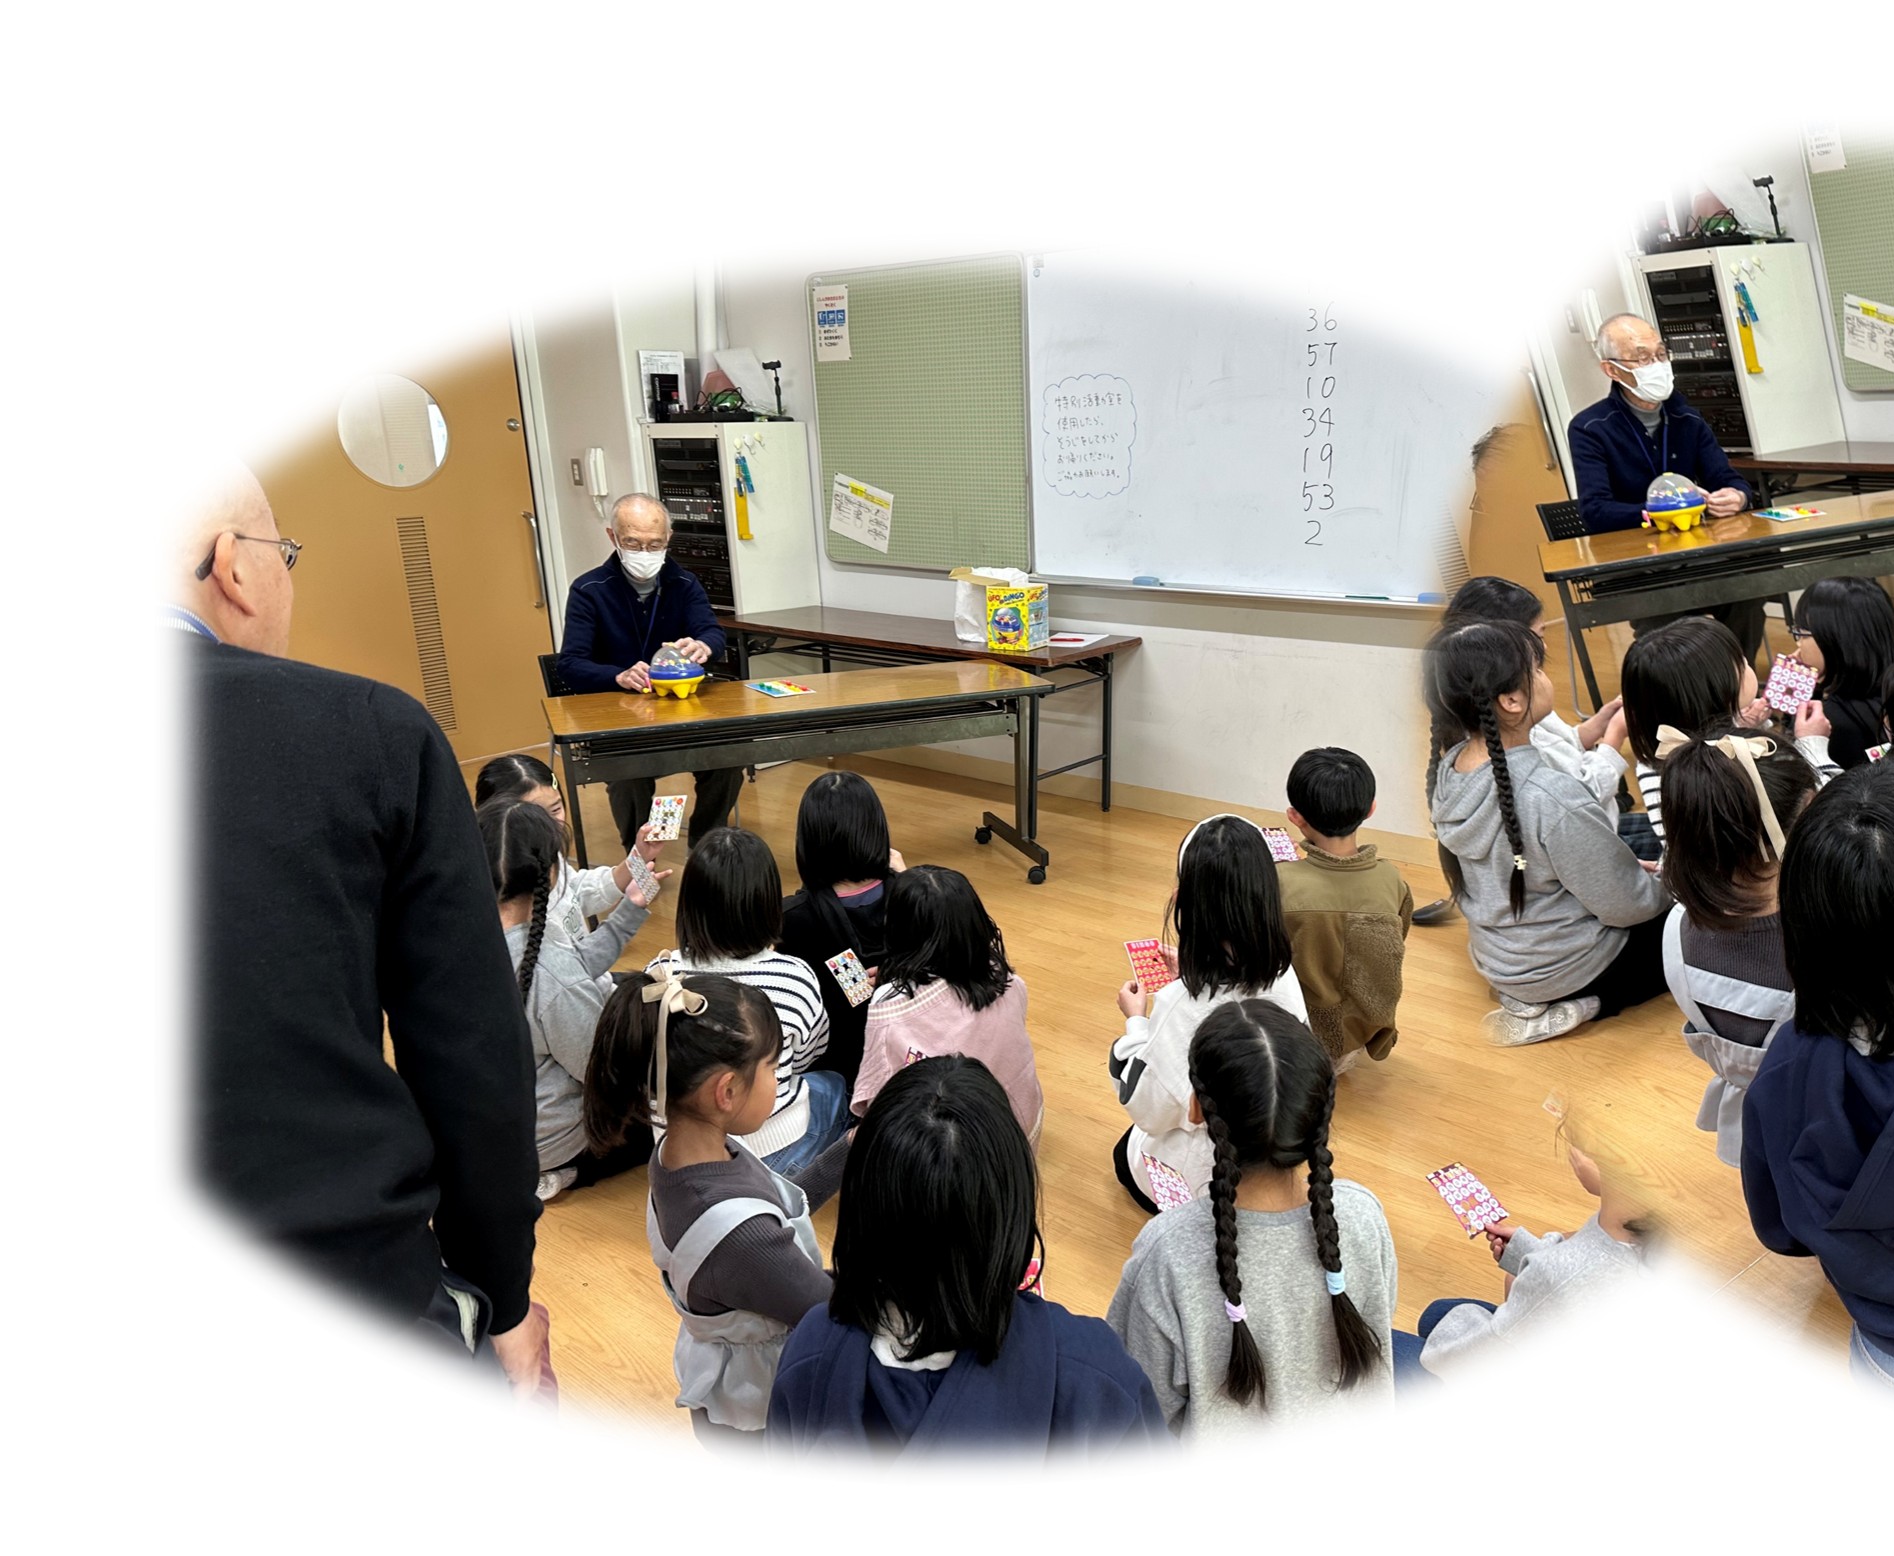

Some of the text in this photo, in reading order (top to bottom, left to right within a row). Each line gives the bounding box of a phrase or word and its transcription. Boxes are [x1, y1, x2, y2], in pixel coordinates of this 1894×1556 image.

[1306, 301, 1337, 332] 36
[1306, 341, 1338, 367] 57
[1305, 375, 1336, 400] 10
[1301, 407, 1335, 438] 34
[1302, 442, 1334, 479] 19
[1301, 481, 1335, 512] 53
[1304, 519, 1324, 546] 2
